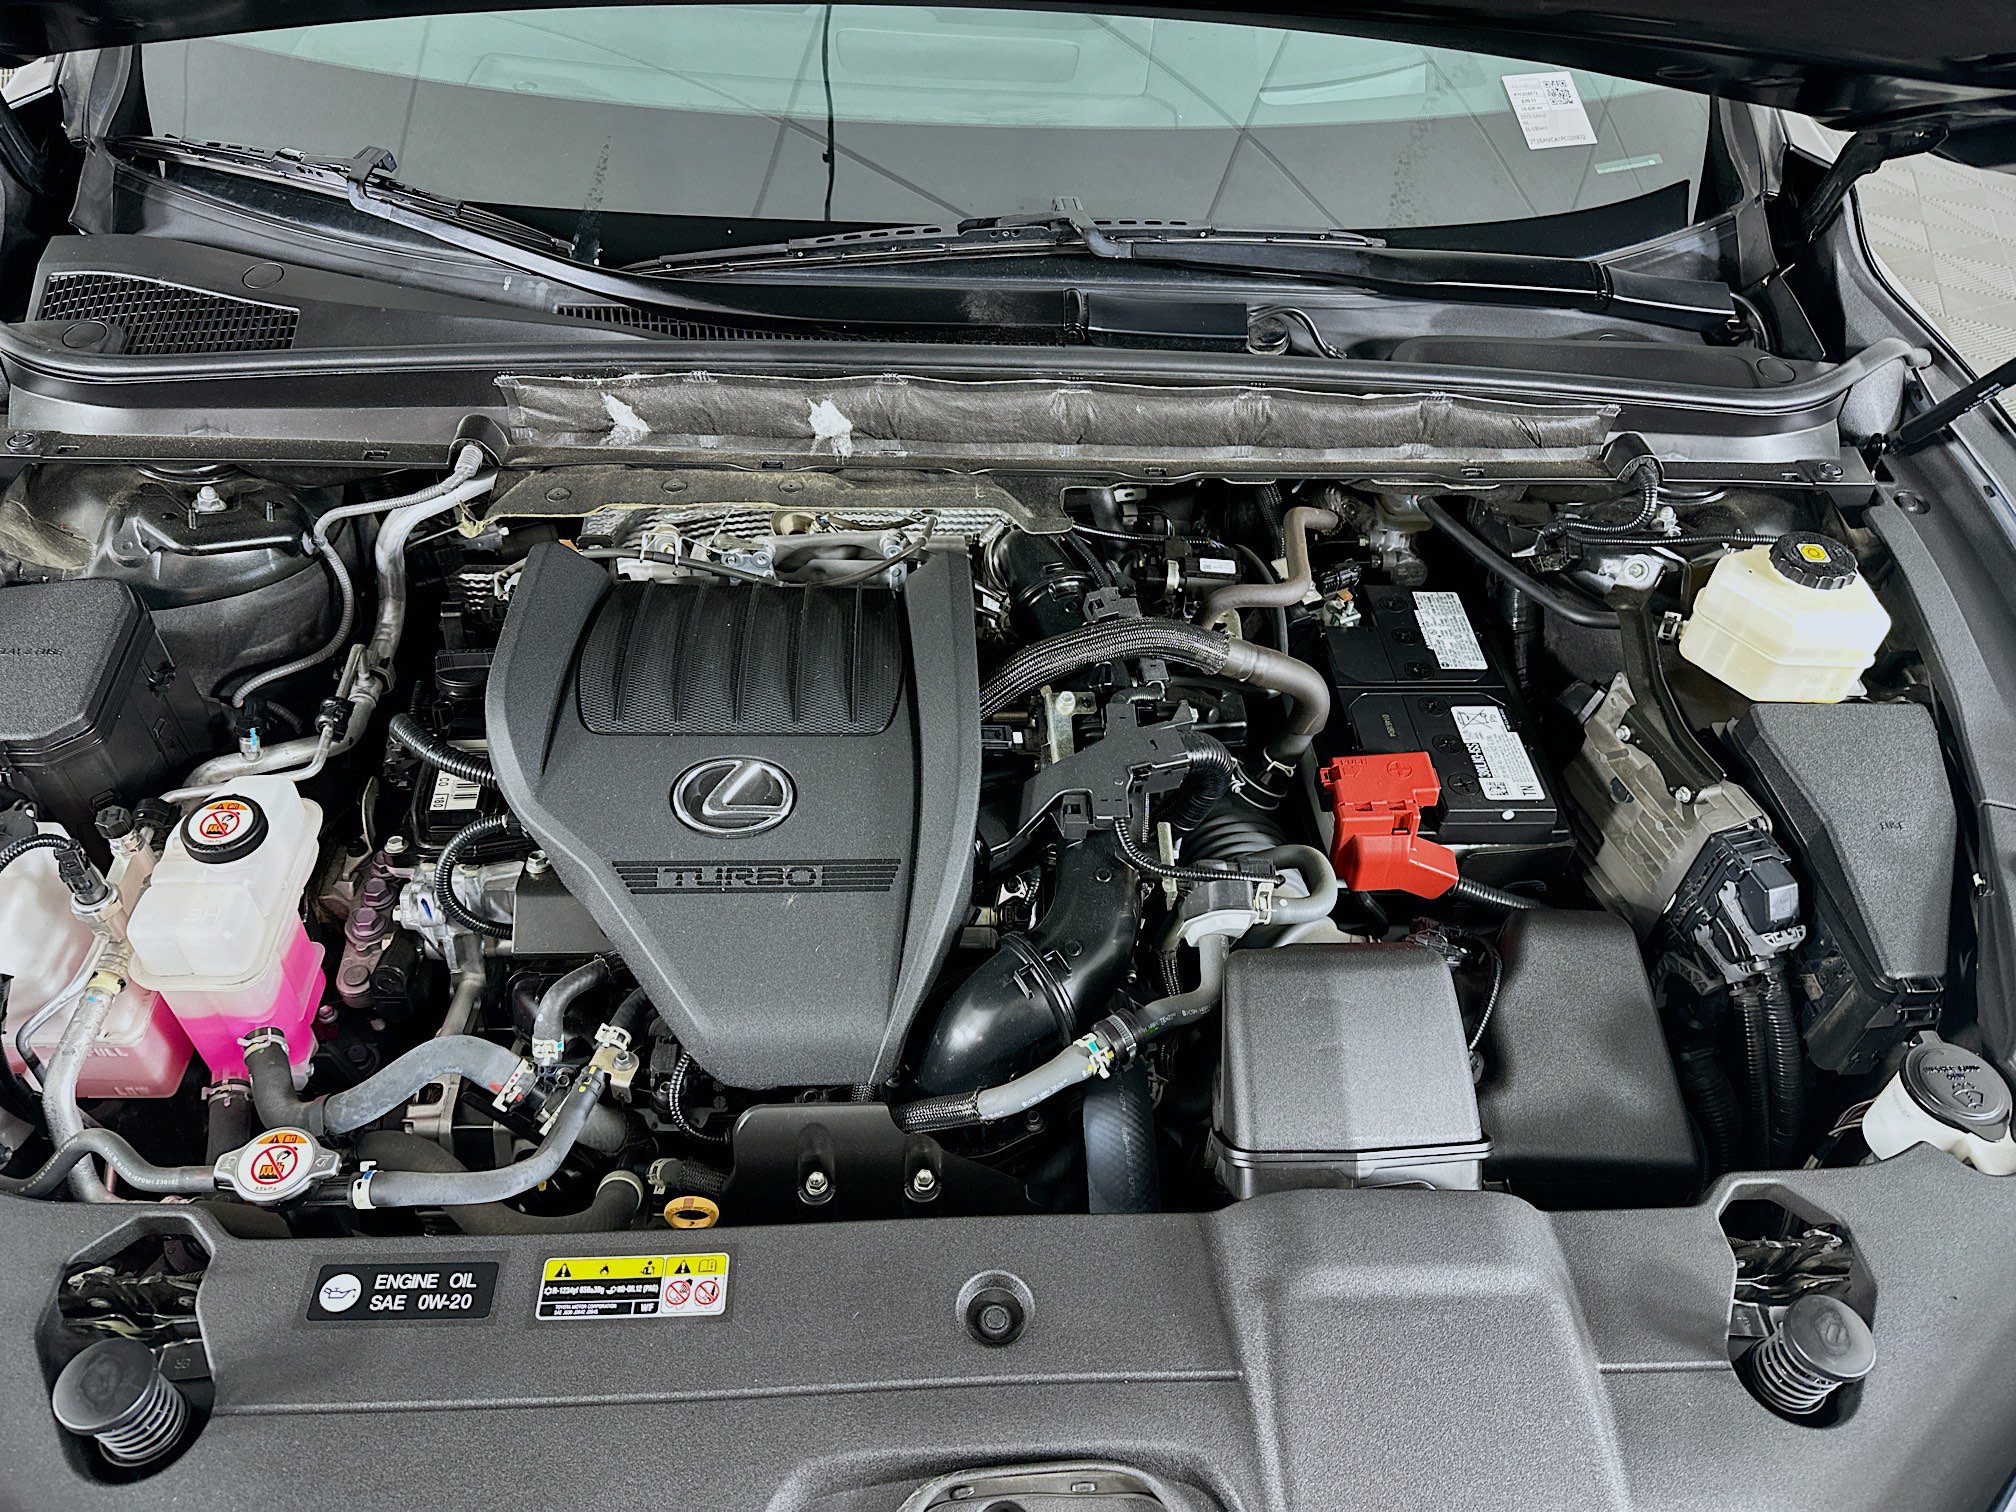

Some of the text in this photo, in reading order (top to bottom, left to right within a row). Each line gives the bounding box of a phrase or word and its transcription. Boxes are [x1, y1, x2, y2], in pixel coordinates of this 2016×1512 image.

[1520, 785, 1537, 796] TN
[662, 867, 817, 887] TURBO
[113, 1086, 151, 1096] LOW
[374, 1272, 477, 1290] ENGINE OIL
[369, 1294, 473, 1311] SAE 0W-20
[640, 1303, 655, 1313] WF
